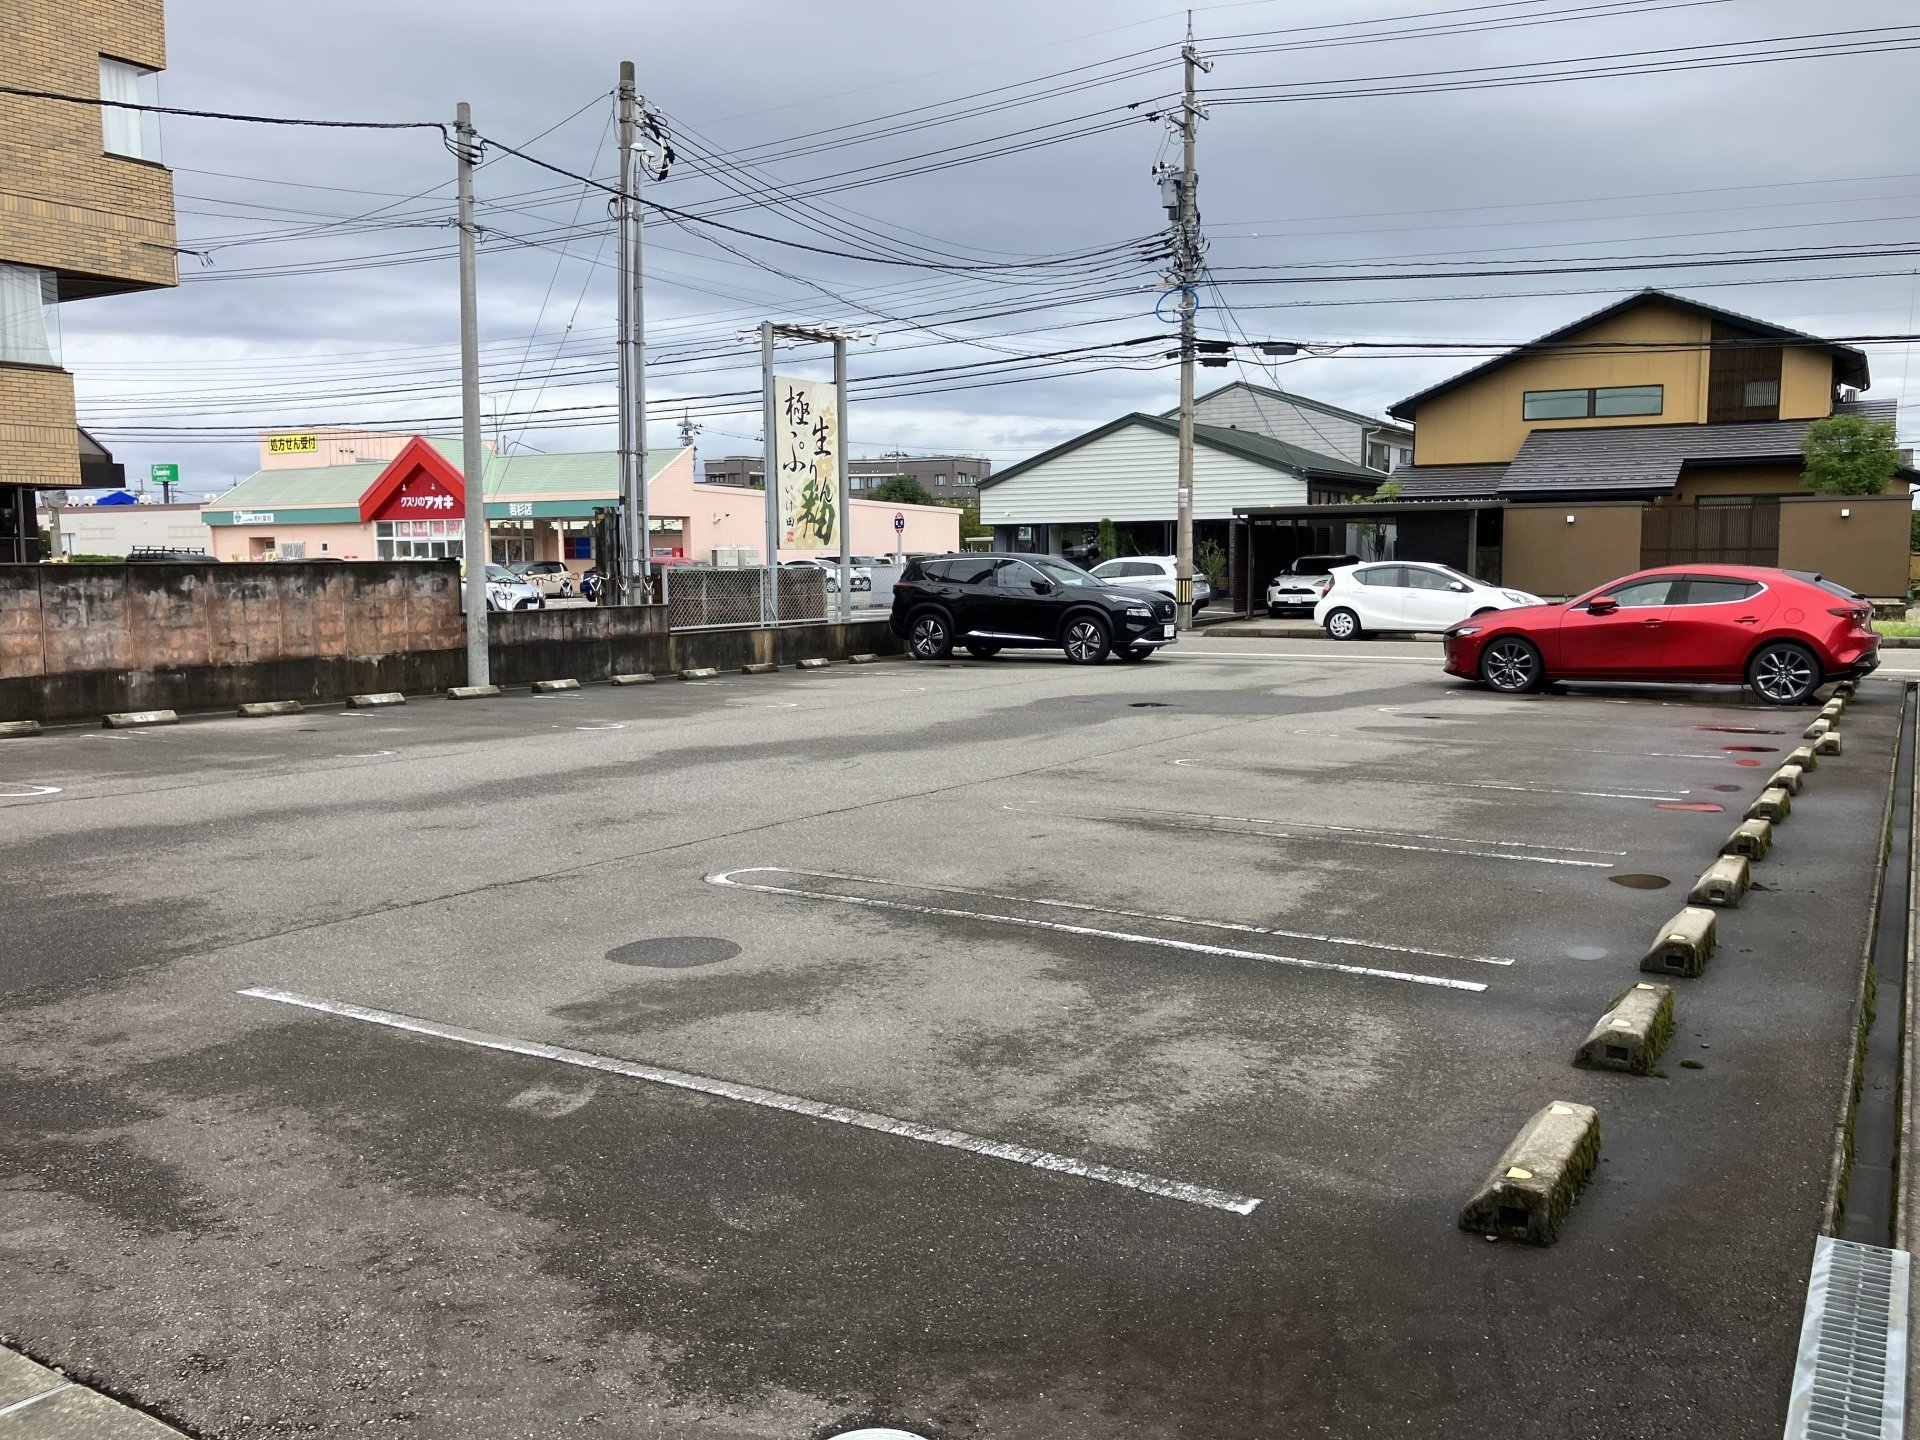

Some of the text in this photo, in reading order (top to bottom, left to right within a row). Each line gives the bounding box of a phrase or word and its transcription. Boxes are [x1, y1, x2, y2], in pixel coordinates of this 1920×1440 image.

[271, 436, 316, 451] 処方せん受付
[401, 495, 454, 510] クスリのアオキ
[509, 503, 533, 516] 若杉店
